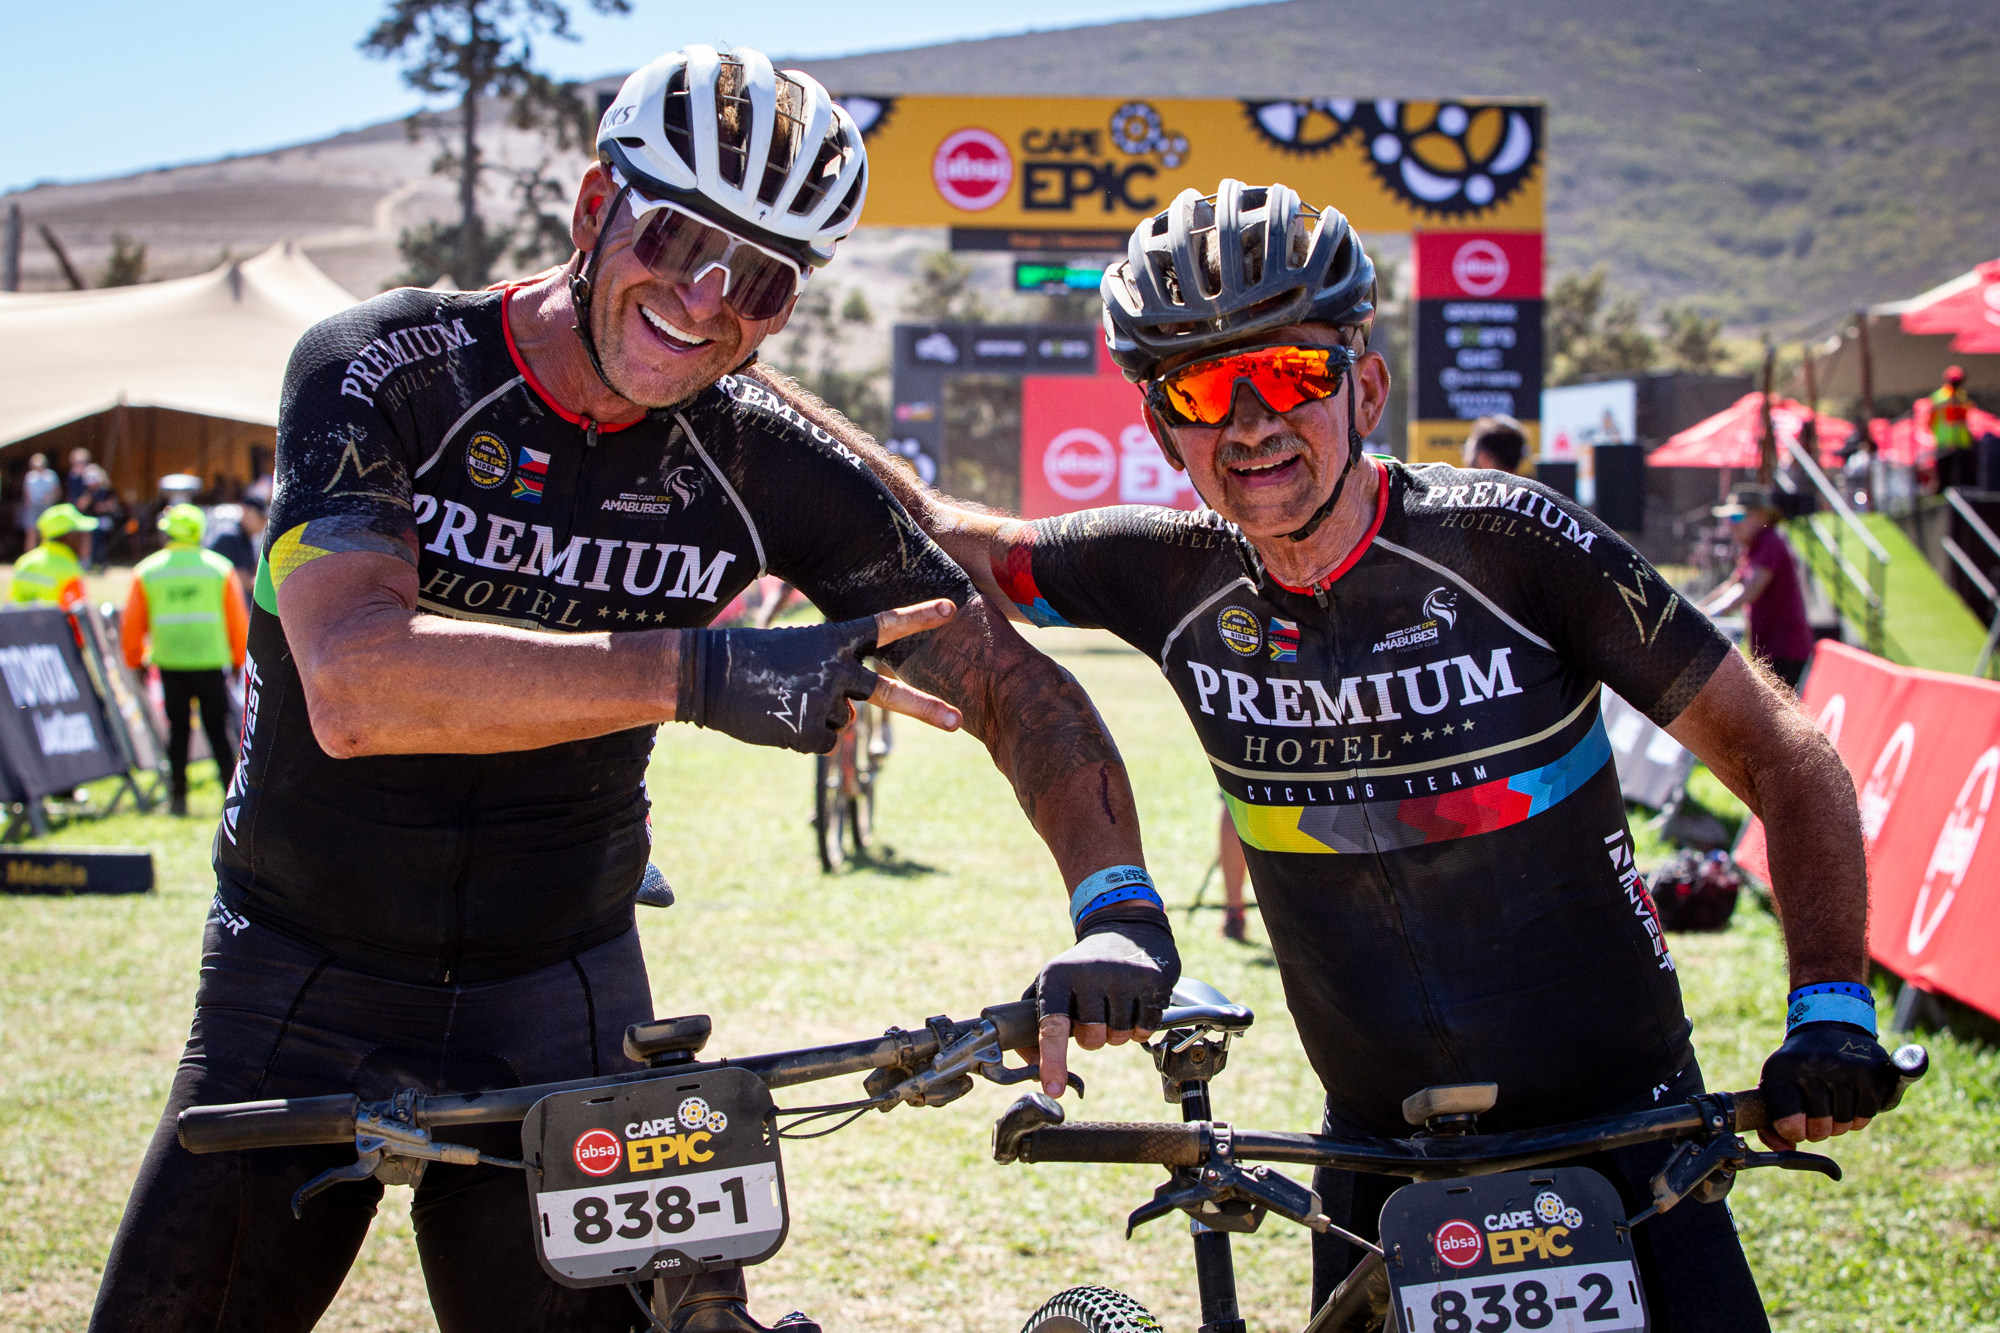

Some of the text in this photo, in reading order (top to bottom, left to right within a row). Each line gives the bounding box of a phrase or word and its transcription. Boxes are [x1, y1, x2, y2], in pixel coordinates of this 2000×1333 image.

[1021, 128, 1102, 156] CAPE
[1023, 161, 1158, 211] EPIC
[340, 317, 478, 408] PREMIUM
[384, 368, 432, 412] HOTEL
[714, 398, 792, 443] HOTEL
[716, 374, 862, 470] REMIUM
[470, 448, 506, 468] CAPE EPIC
[474, 460, 496, 473] RIDER
[601, 499, 671, 515] AMABUBESI
[638, 494, 657, 502] CAPE
[1419, 481, 1598, 554] PREMIUM
[1440, 512, 1519, 537] HOTEL
[412, 492, 737, 604] PREMIUM
[420, 567, 584, 628] HOTEL
[1221, 621, 1258, 636] CAPE EPIC
[1230, 631, 1250, 642] RIDER
[1372, 627, 1439, 653] AMABUBESI
[1404, 620, 1438, 634] CAPE EPIC
[1424, 639, 1440, 648] CLUB
[1187, 647, 1524, 728] PREMIUM
[1243, 733, 1393, 766] HOTEL
[1247, 765, 1488, 802] CYCLING TEAM
[625, 1116, 676, 1140] CAPE
[581, 1143, 616, 1159] absa
[626, 1131, 716, 1173] EPIC
[572, 1176, 749, 1245] 838-1
[1484, 1210, 1534, 1231] CAPE
[1441, 1234, 1477, 1251] absa
[1486, 1225, 1574, 1265] EPIC
[653, 1257, 681, 1270] 2025
[1430, 1272, 1620, 1333] 838-2
